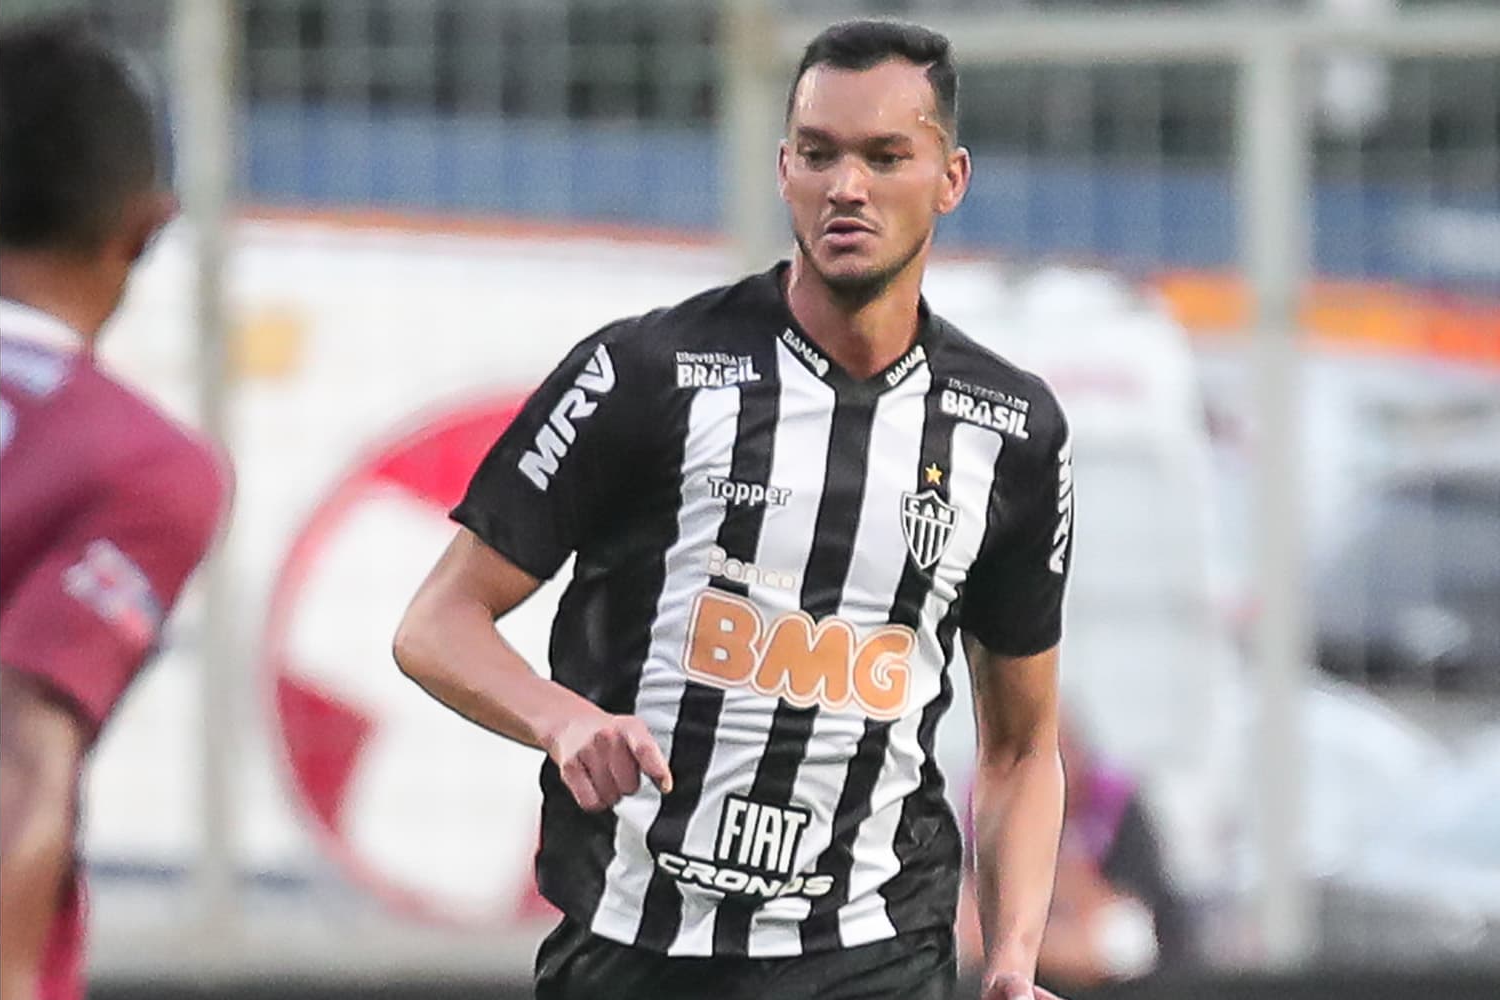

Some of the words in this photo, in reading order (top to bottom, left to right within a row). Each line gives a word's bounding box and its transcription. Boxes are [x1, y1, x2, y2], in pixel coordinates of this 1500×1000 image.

[676, 362, 762, 388] BRASIL
[518, 343, 617, 491] MRV
[940, 389, 1031, 439] BRASIL
[708, 477, 792, 505] Topper
[707, 549, 797, 589] Banco
[682, 588, 917, 720] BMG
[718, 797, 807, 874] FIAT
[657, 852, 835, 897] CRONOS
